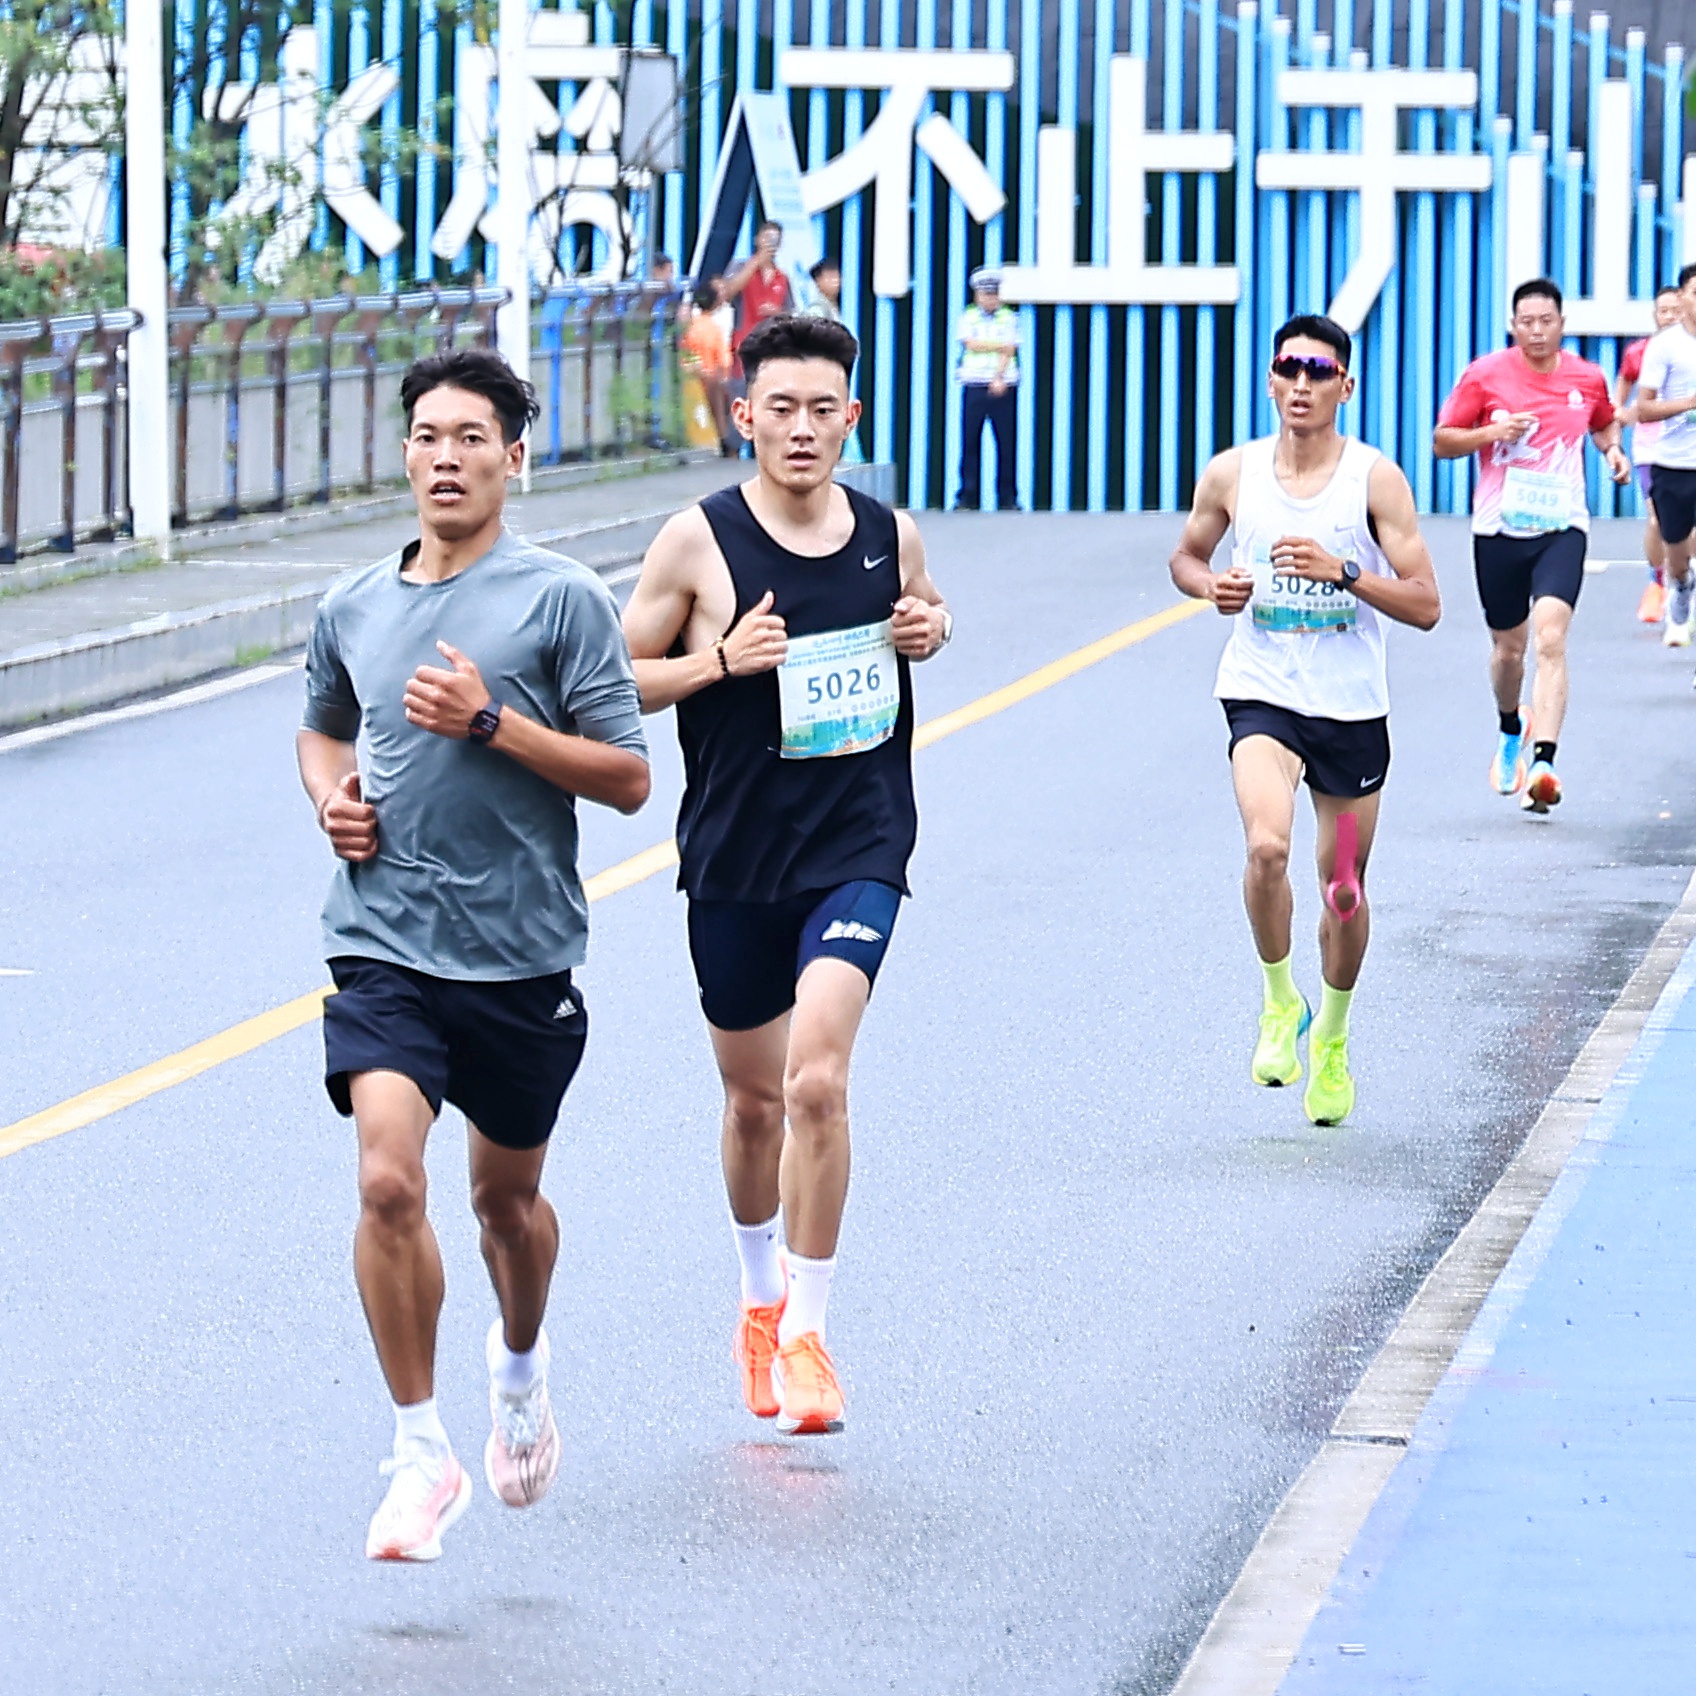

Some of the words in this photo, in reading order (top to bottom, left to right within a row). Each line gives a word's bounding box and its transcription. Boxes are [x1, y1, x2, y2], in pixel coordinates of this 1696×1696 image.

[1516, 487, 1559, 507] 5049
[1271, 574, 1335, 597] 5028
[807, 663, 881, 705] 5026
